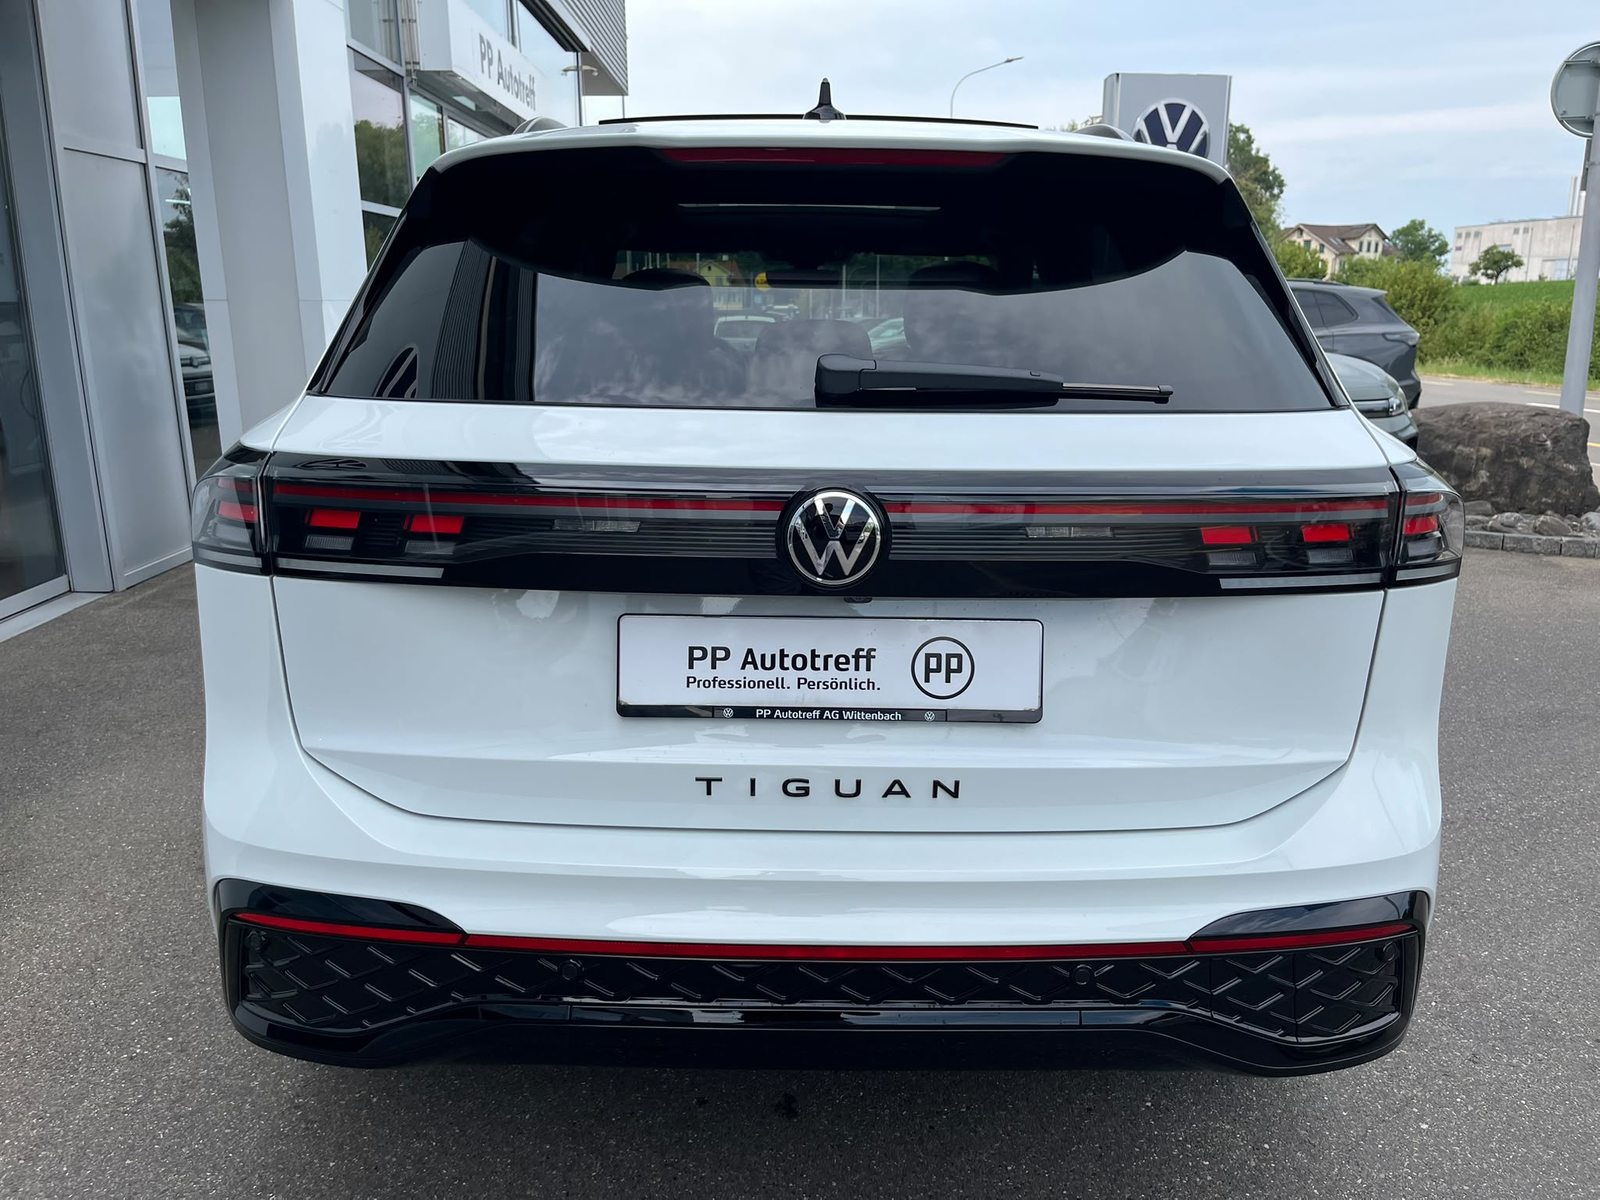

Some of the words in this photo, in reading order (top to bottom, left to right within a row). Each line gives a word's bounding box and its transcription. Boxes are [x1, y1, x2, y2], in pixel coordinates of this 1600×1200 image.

[479, 33, 493, 79] PP
[497, 50, 536, 111] Autotreff
[687, 646, 731, 670] PP
[740, 647, 877, 671] Autotreff
[923, 652, 964, 684] PP
[686, 676, 791, 690] Professionell.
[797, 677, 881, 691] Persönlich.
[755, 708, 771, 718] PP
[773, 708, 821, 719] Autotreff
[823, 709, 839, 720] AG
[842, 710, 902, 721] Wittenbach
[694, 776, 961, 799] TIGUAN
